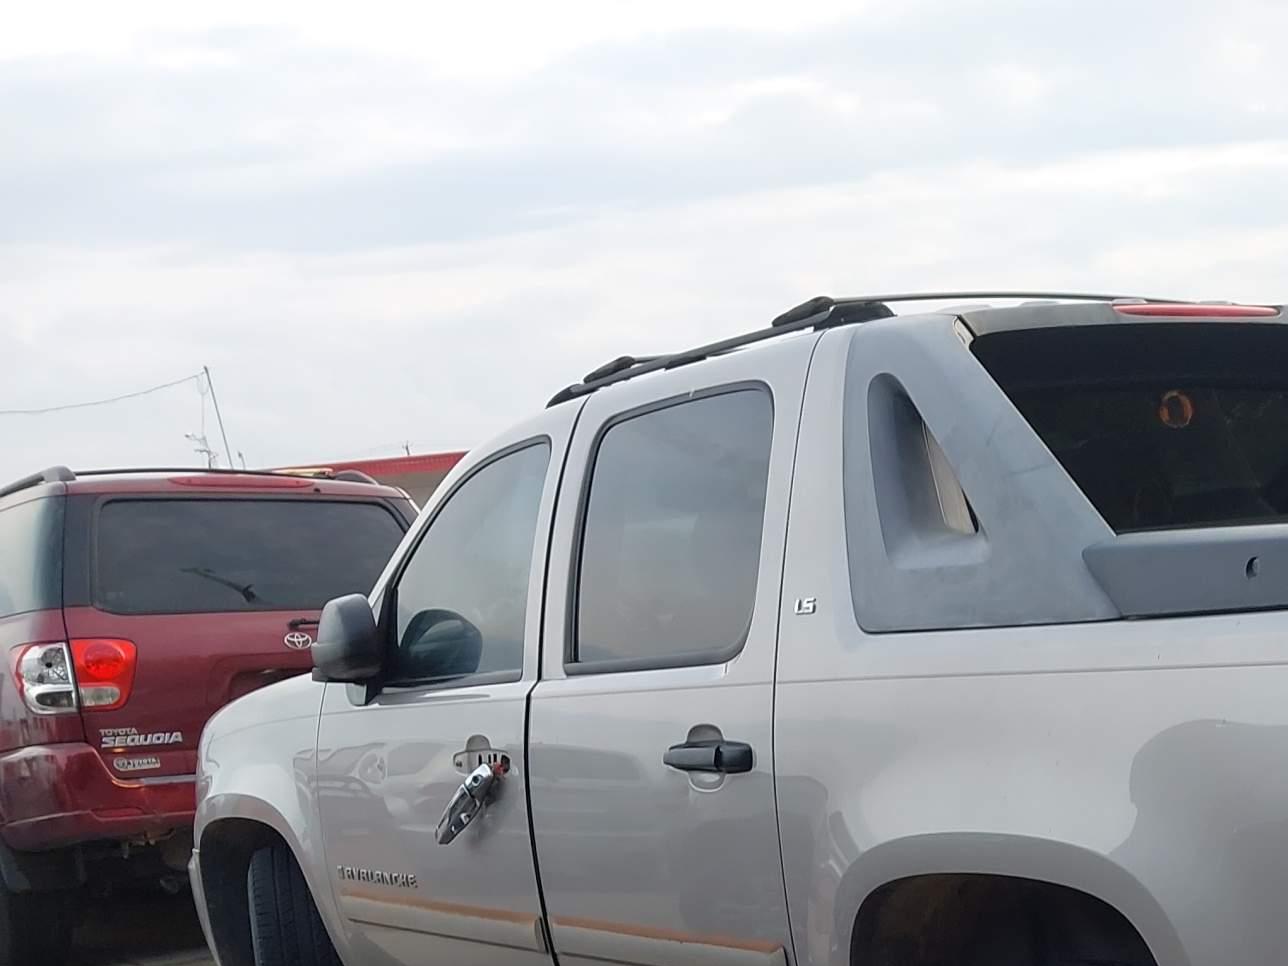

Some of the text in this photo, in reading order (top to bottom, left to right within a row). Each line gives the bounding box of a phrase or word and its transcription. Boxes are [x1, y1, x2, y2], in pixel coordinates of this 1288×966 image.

[794, 597, 817, 616] LS
[99, 727, 138, 737] TOYOTA
[101, 731, 183, 749] SEQUOIA
[345, 866, 419, 889] AVALANCHE
